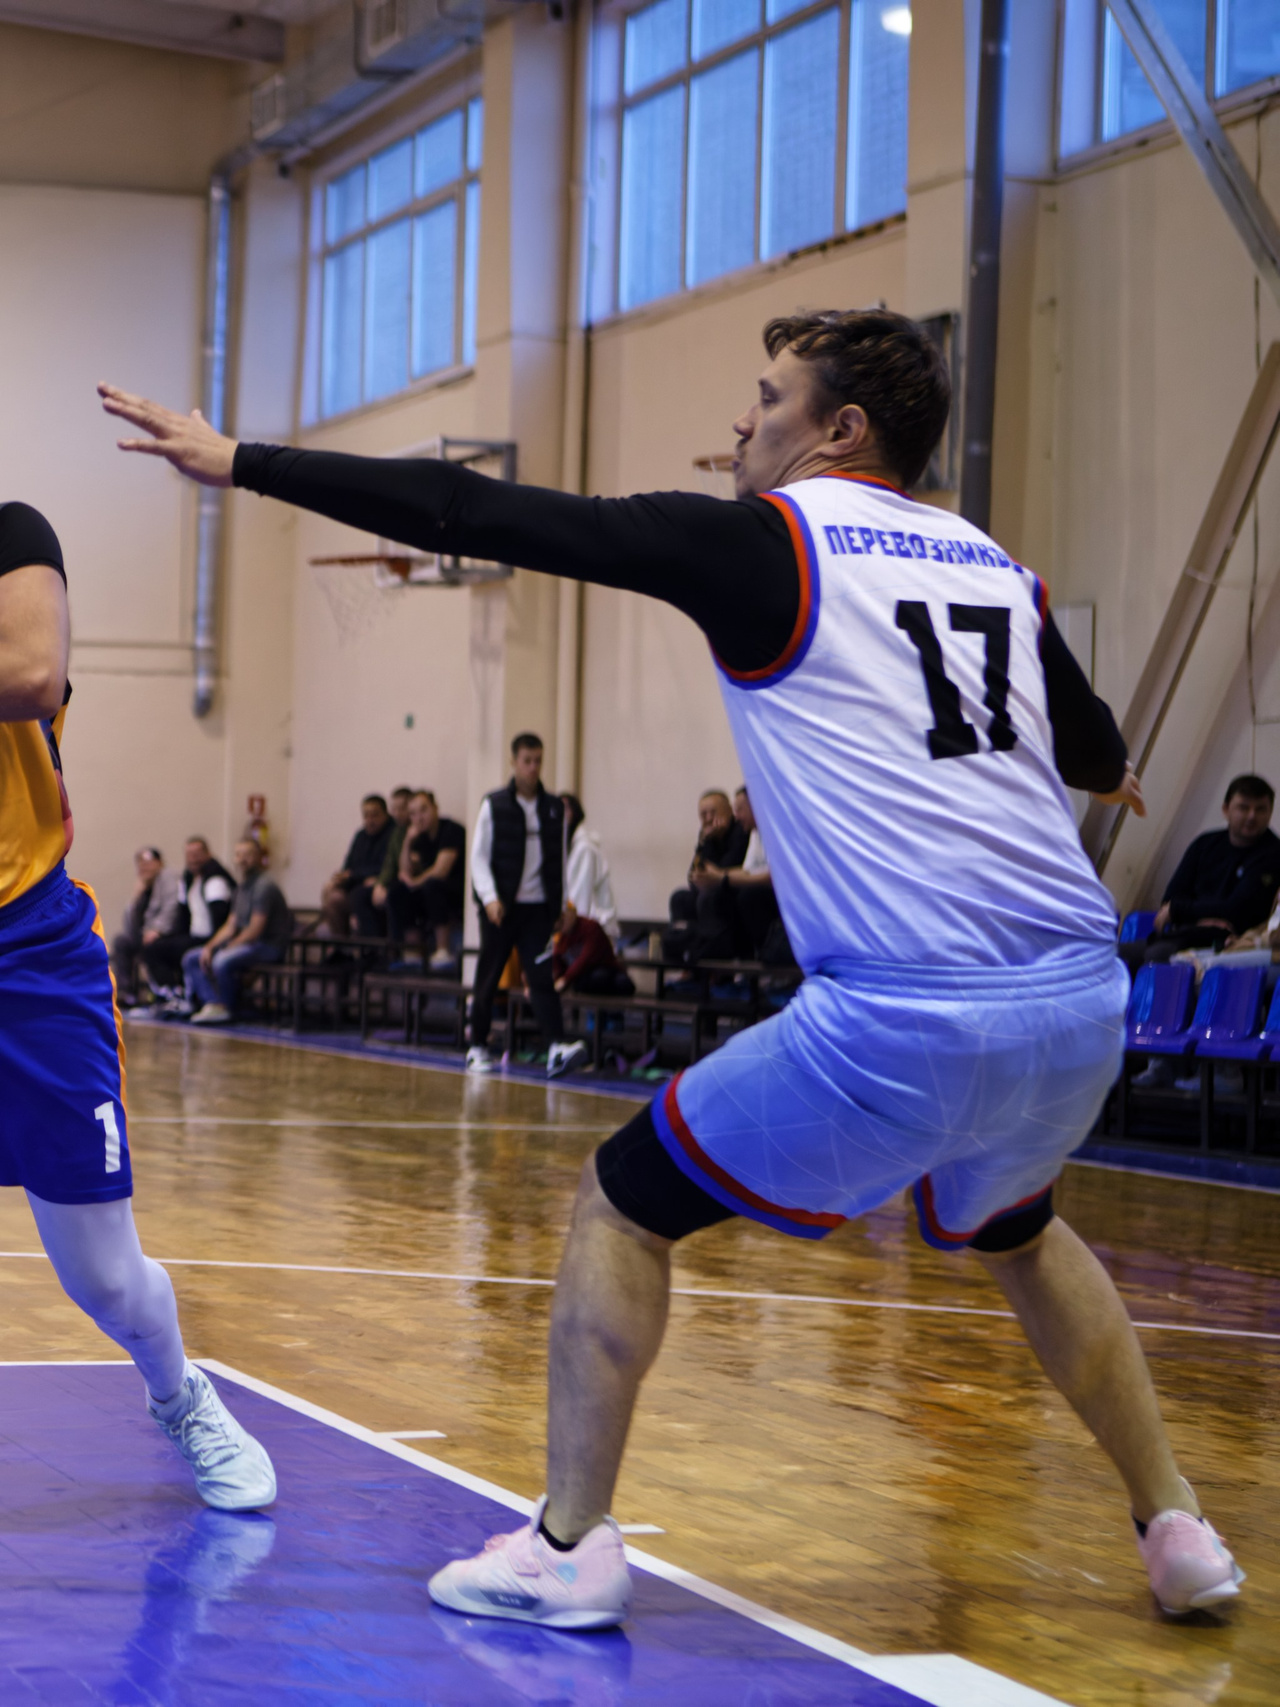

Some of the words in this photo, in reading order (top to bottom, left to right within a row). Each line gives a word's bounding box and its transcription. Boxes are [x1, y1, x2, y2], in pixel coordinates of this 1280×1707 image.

[822, 525, 1024, 574] ПЕРЕВОЗНИКО
[894, 599, 1018, 760] 17
[94, 1101, 121, 1173] 1
